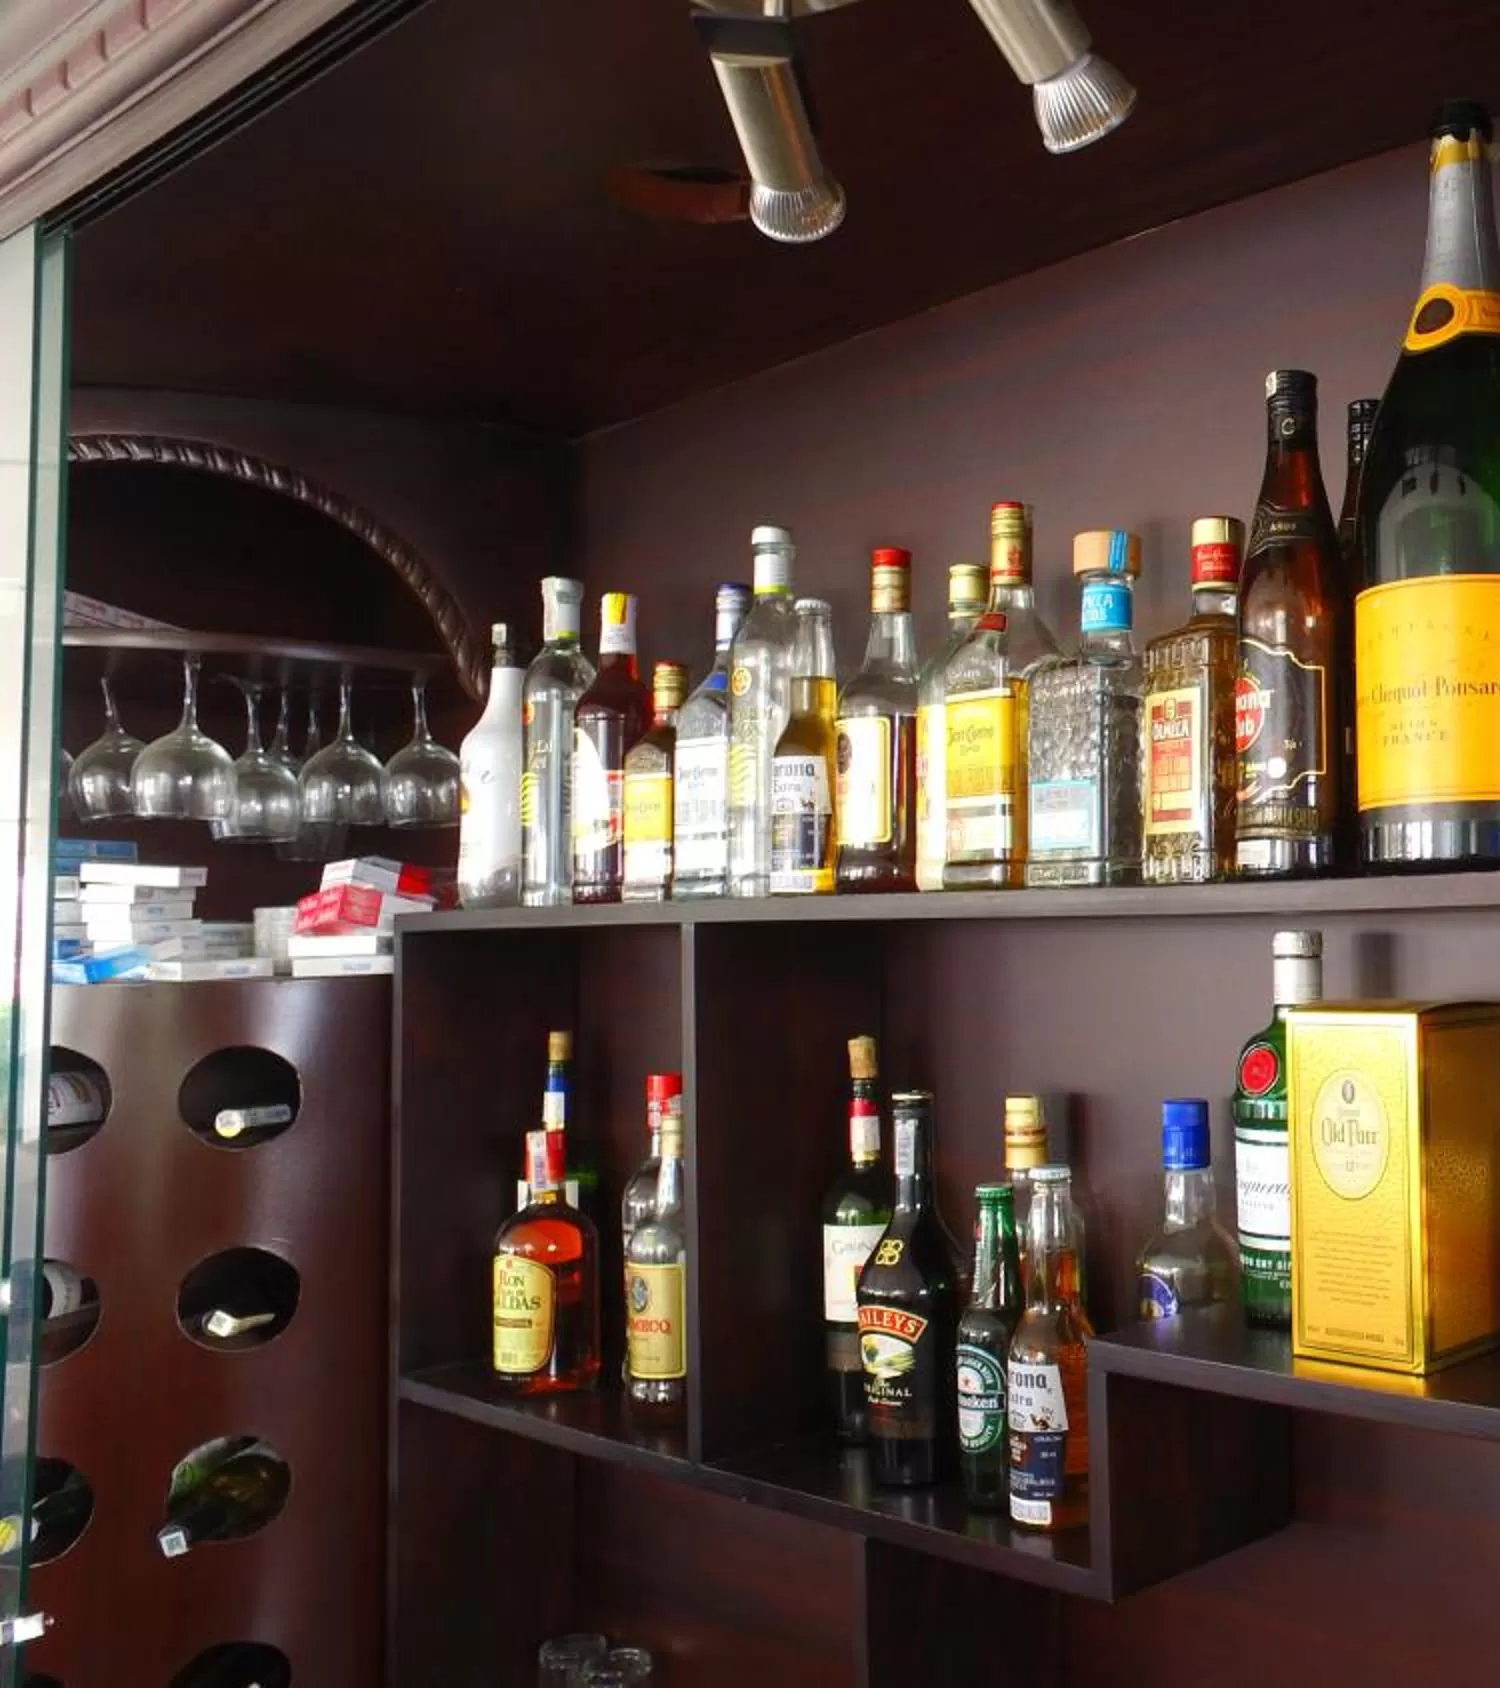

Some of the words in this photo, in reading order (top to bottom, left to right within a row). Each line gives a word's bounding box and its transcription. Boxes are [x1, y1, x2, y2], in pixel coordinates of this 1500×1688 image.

[630, 1318, 672, 1336] MECQ
[859, 1309, 918, 1334] AILEYS
[1009, 1370, 1048, 1391] rona
